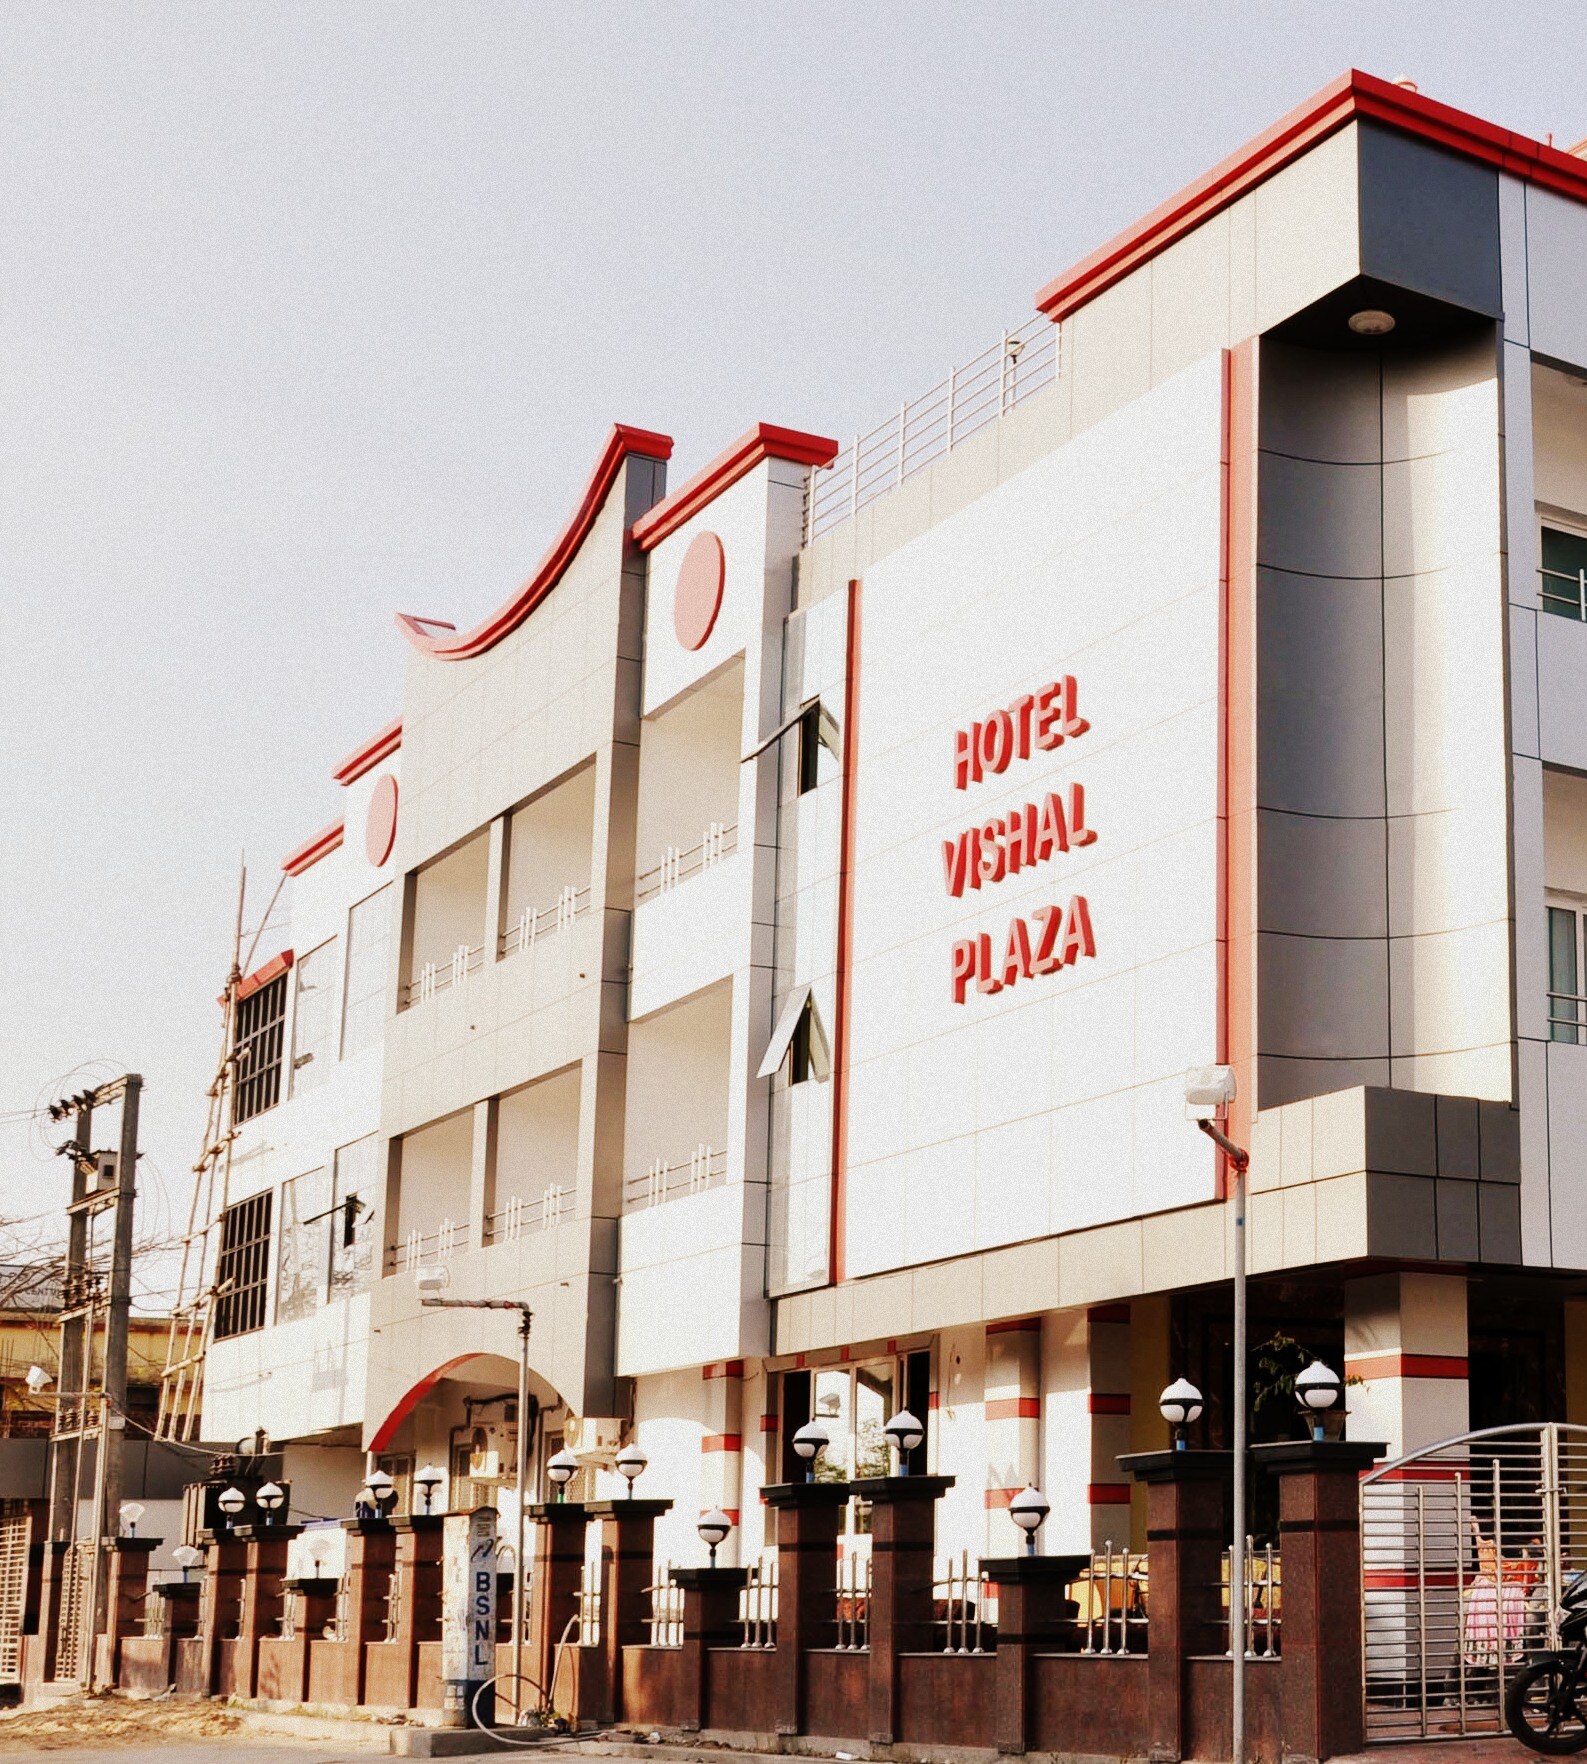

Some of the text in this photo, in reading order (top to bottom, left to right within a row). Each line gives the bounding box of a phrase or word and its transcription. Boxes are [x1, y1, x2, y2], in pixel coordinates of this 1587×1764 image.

[954, 675, 1091, 790] HOTEL
[941, 782, 1098, 898] VISHAL
[951, 895, 1097, 1005] PLAZA
[475, 1571, 492, 1666] BSNL
